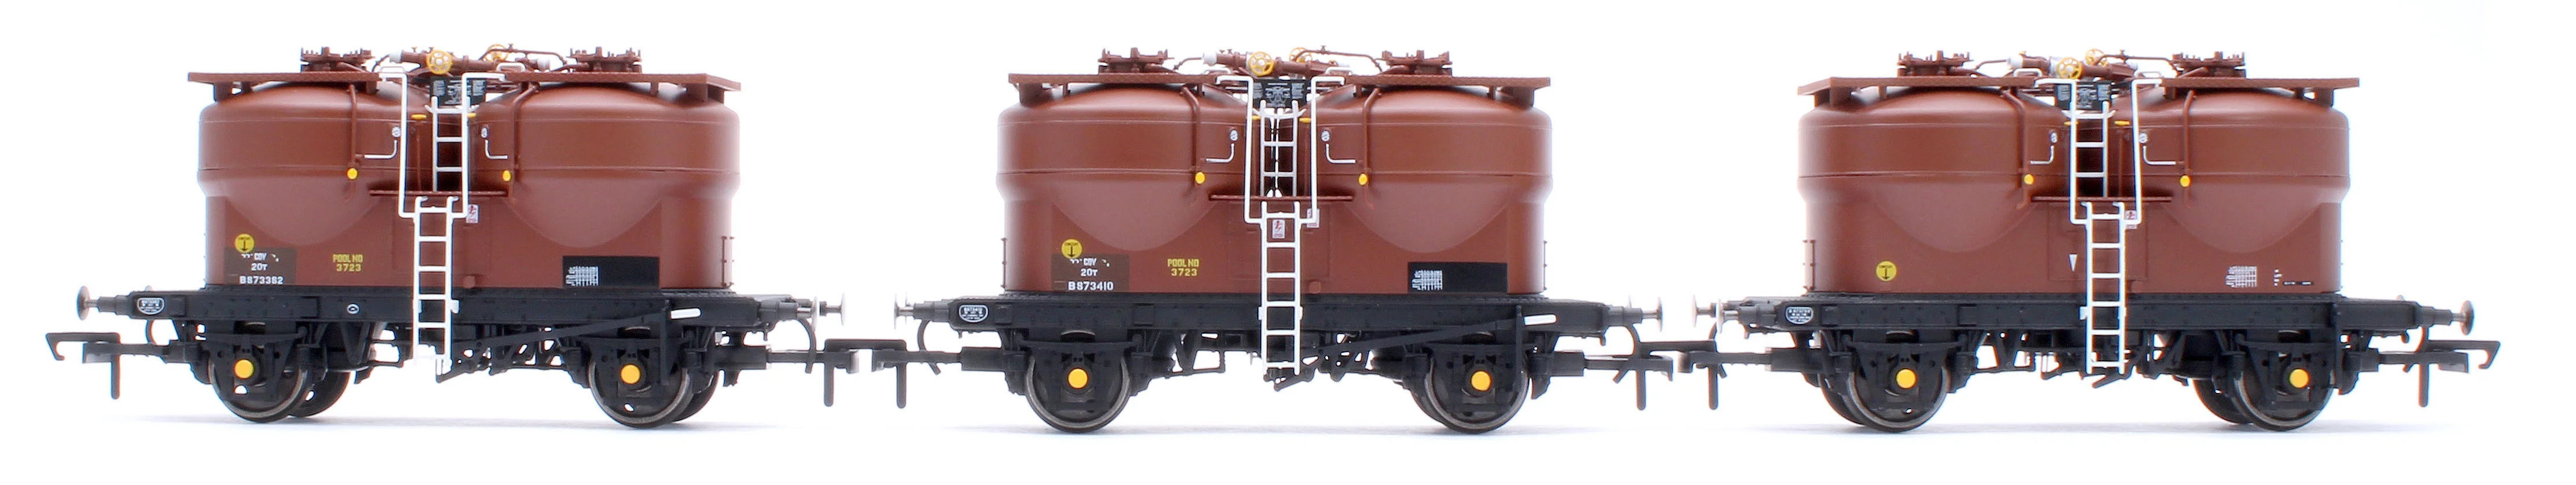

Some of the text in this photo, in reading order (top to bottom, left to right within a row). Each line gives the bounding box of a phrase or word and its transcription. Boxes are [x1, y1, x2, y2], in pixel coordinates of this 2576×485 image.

[1167, 258, 1187, 267] POOL
[336, 263, 362, 272] 3723
[1171, 268, 1198, 277] 3723
